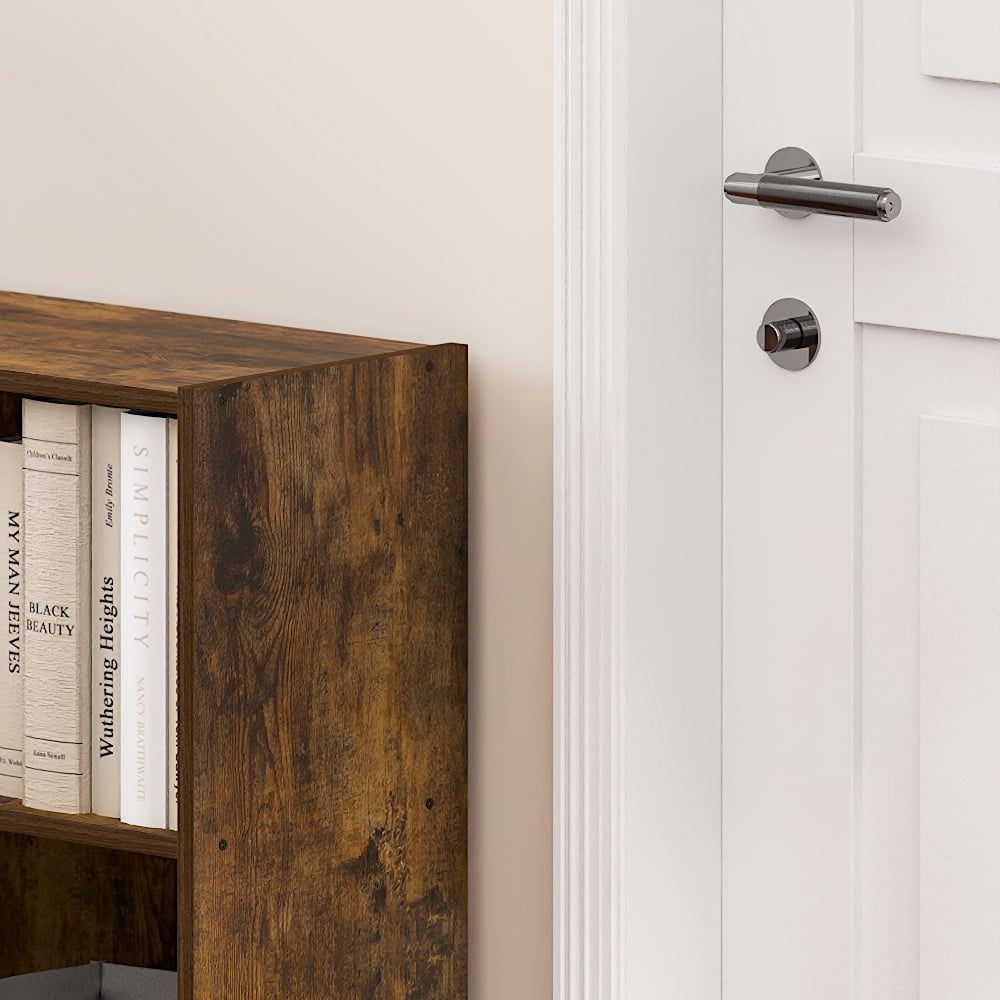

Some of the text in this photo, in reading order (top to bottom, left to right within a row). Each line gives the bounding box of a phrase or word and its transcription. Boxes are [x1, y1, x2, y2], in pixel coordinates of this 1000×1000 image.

[105, 463, 115, 528] Emily Bronte
[133, 446, 149, 649] SIMPLICITY
[8, 511, 21, 674] MY MAN JEEVES
[26, 619, 75, 637] BEAUTY
[29, 601, 71, 618] BLACK
[99, 576, 118, 759] Wuthering Heights
[135, 676, 146, 802] NANCY BRAITHWAITE
